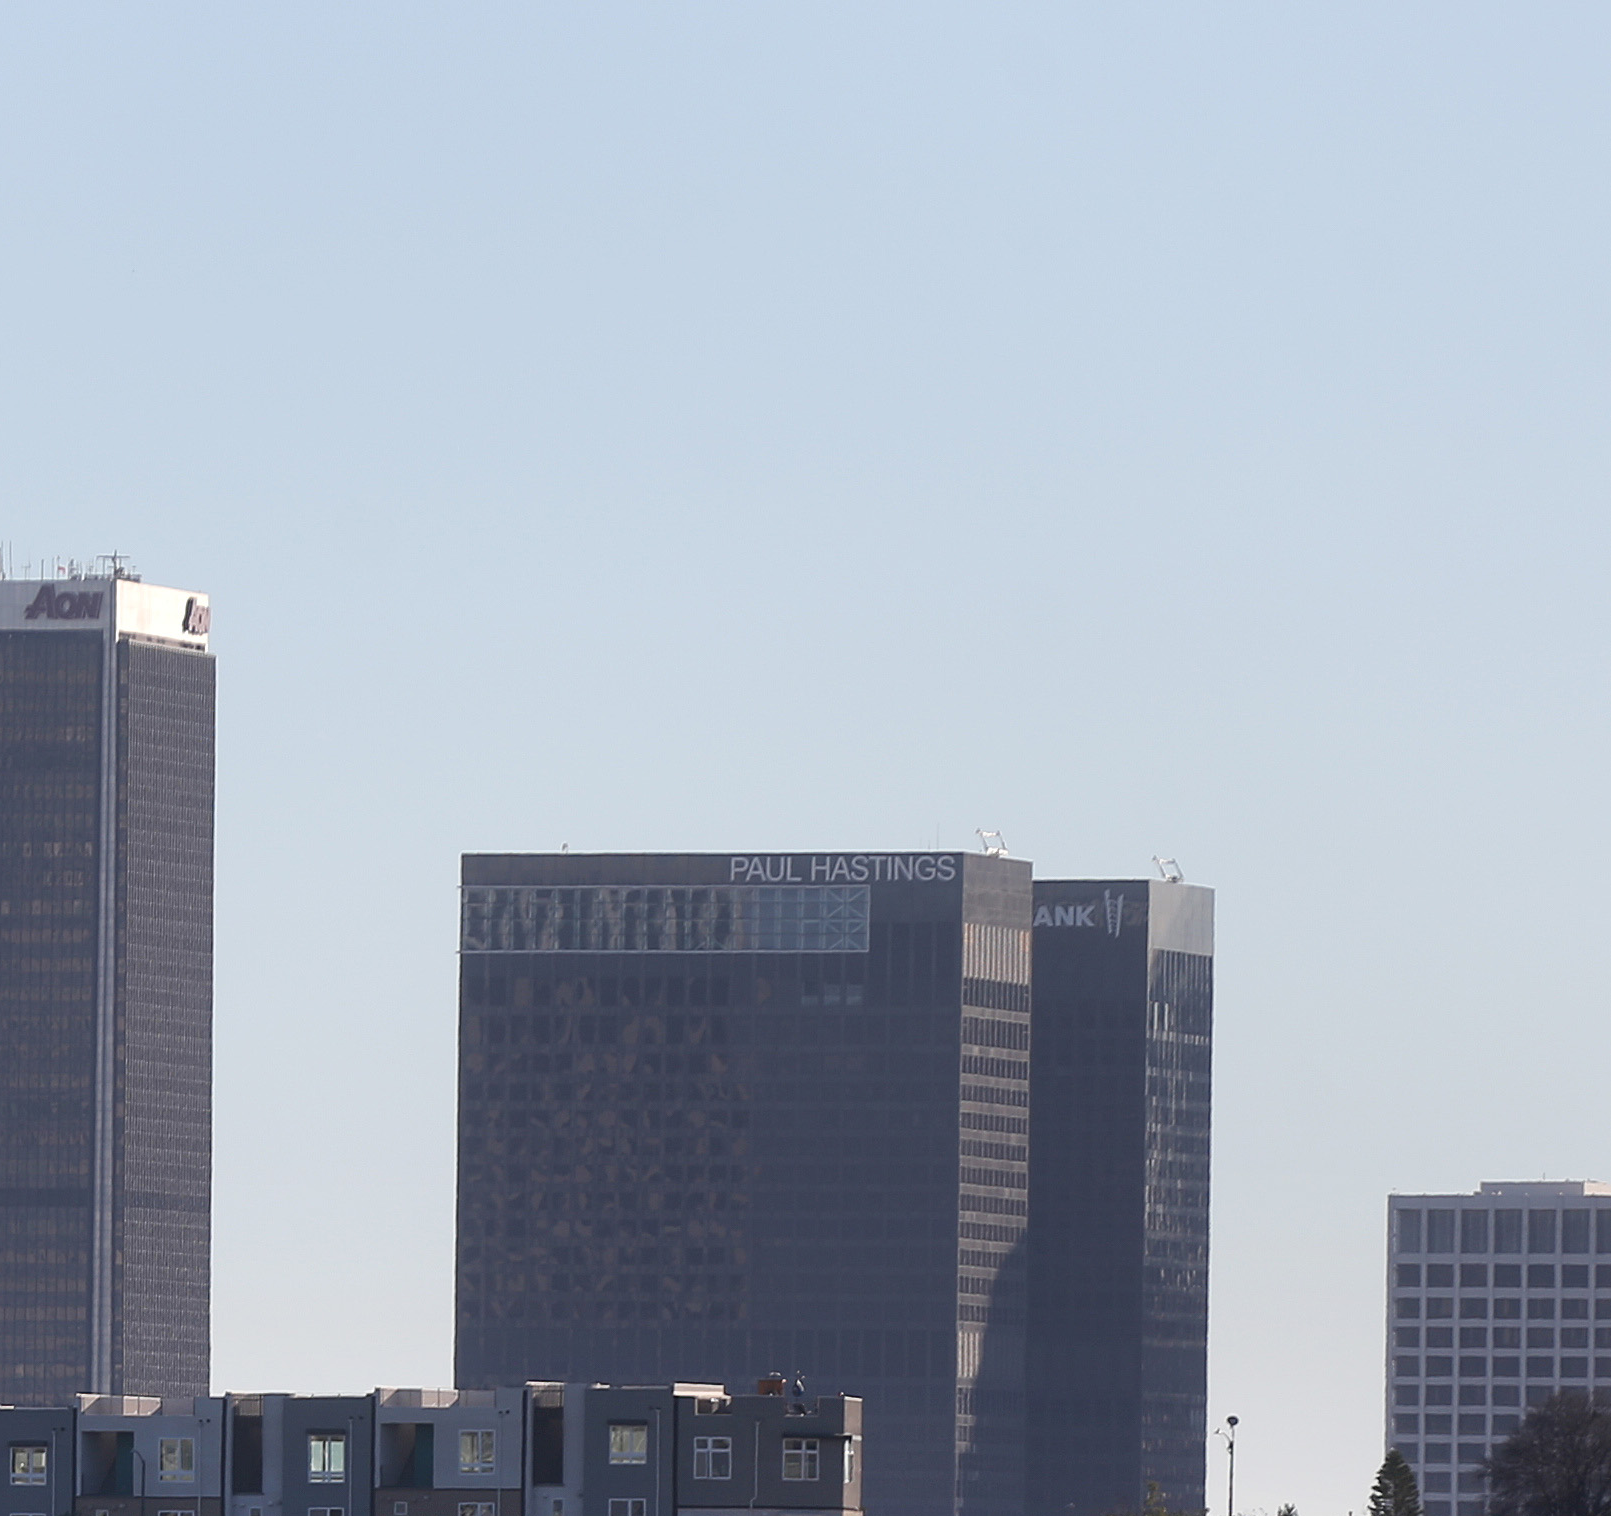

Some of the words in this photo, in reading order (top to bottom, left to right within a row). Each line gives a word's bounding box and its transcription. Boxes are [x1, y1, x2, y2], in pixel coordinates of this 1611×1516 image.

[730, 856, 802, 882] PAUL
[811, 855, 956, 882] HASTINGS
[1032, 905, 1096, 927] ANK
